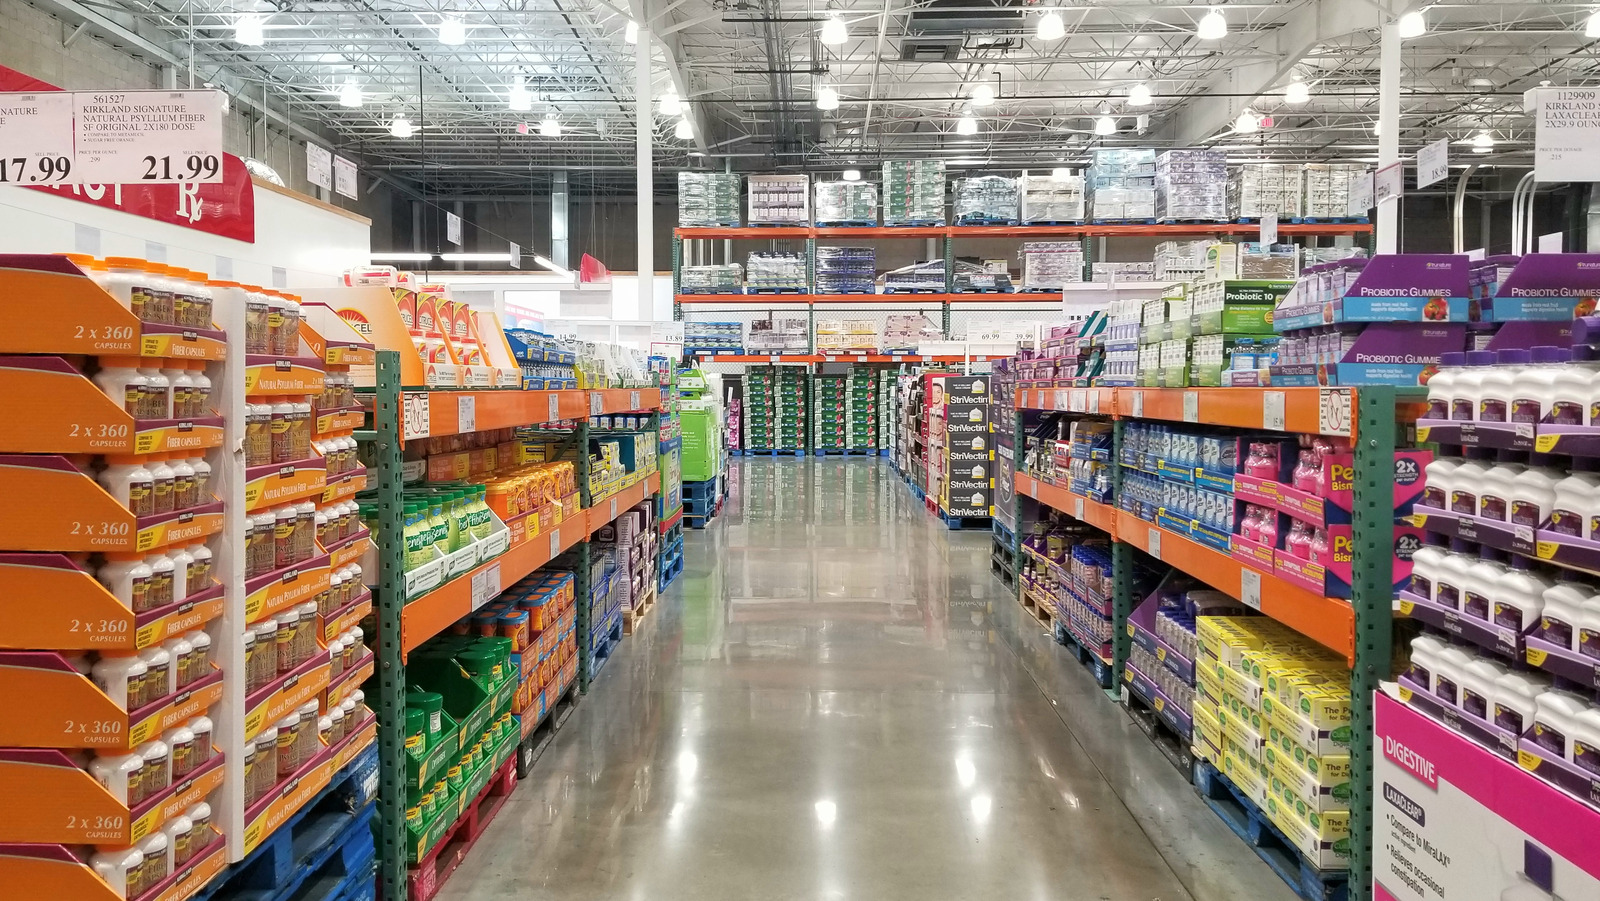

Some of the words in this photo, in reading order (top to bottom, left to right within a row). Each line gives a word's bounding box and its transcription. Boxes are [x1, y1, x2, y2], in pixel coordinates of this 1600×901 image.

[93, 95, 125, 103] 561527
[1558, 92, 1595, 100] 1129909
[0, 157, 71, 182] 17.99
[142, 155, 219, 180] 21.99
[74, 326, 83, 339] 2
[102, 326, 133, 340] 360
[1405, 354, 1441, 364] GUMMIE
[69, 424, 79, 437] 2
[97, 424, 128, 438] 360
[1331, 464, 1353, 481] Pe
[1332, 482, 1353, 491] Bism
[71, 522, 80, 535] 2
[99, 522, 129, 535] 360
[1335, 536, 1352, 552] Pe
[70, 620, 80, 632] 2
[98, 620, 128, 633] 360
[64, 721, 74, 733] 2
[92, 721, 121, 734] 360
[1386, 736, 1435, 783] DIGESTIVE
[66, 816, 76, 829] 2
[94, 816, 123, 829] 360
[1390, 814, 1415, 842] Compare
[1416, 834, 1422, 847] to
[1390, 844, 1413, 872] Relieves
[1414, 861, 1444, 898] occasional
[1391, 864, 1425, 898] constipation
